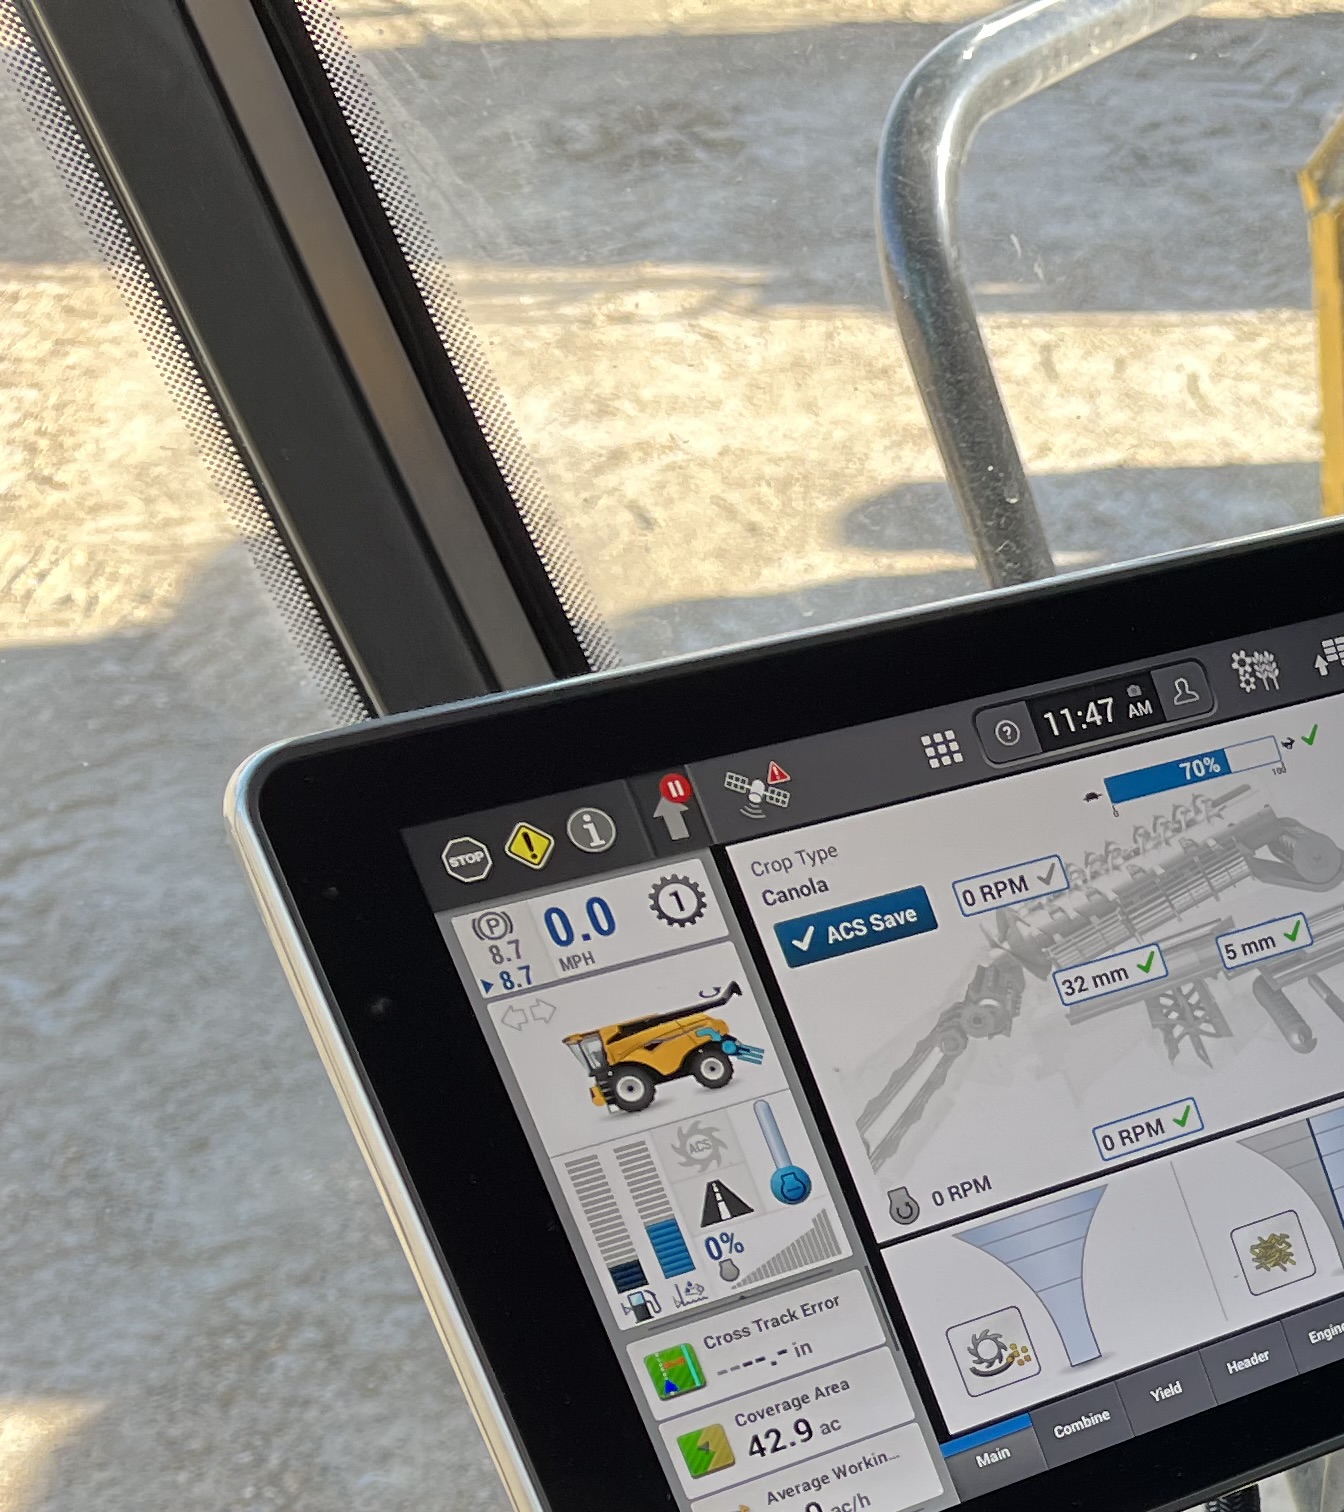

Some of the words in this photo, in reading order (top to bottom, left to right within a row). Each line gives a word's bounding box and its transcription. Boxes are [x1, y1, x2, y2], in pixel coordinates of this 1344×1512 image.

[1044, 698, 1114, 737] 11:47
[1126, 699, 1153, 720] AM
[1179, 757, 1221, 780] 70%
[449, 851, 485, 868] STOP
[751, 856, 793, 879] Crop
[795, 843, 839, 871] Type
[669, 890, 685, 912] 1
[762, 877, 829, 907] Canola
[962, 889, 976, 907] 0
[980, 875, 1029, 903] RPM
[544, 896, 616, 947] 0.0
[827, 918, 867, 945] ACS
[872, 907, 917, 932] Save
[488, 939, 521, 965] 8.7
[558, 951, 596, 972] MPH
[1225, 943, 1237, 961] 5
[1241, 934, 1277, 957] mm
[499, 965, 533, 990] 8.7
[1061, 974, 1089, 997] 32
[1092, 964, 1129, 989] mm
[688, 1138, 712, 1154] ACS
[1101, 1134, 1116, 1153] 0
[1118, 1118, 1166, 1148] RPM
[931, 1188, 945, 1207] 0
[947, 1175, 992, 1203] RPM
[704, 1231, 745, 1261] 0%
[703, 1326, 751, 1350] Cross
[752, 1308, 800, 1333] Track
[800, 1295, 840, 1318] Error
[793, 1341, 813, 1358] in
[1226, 1349, 1270, 1375] Header
[734, 1394, 811, 1428] Coverage
[813, 1378, 851, 1402] Area
[1150, 1381, 1183, 1402] Yield
[748, 1418, 814, 1459] 42.9
[819, 1419, 842, 1435] ac
[1053, 1409, 1111, 1439] Combine
[975, 1446, 1011, 1468] Main
[766, 1474, 831, 1505] Average
